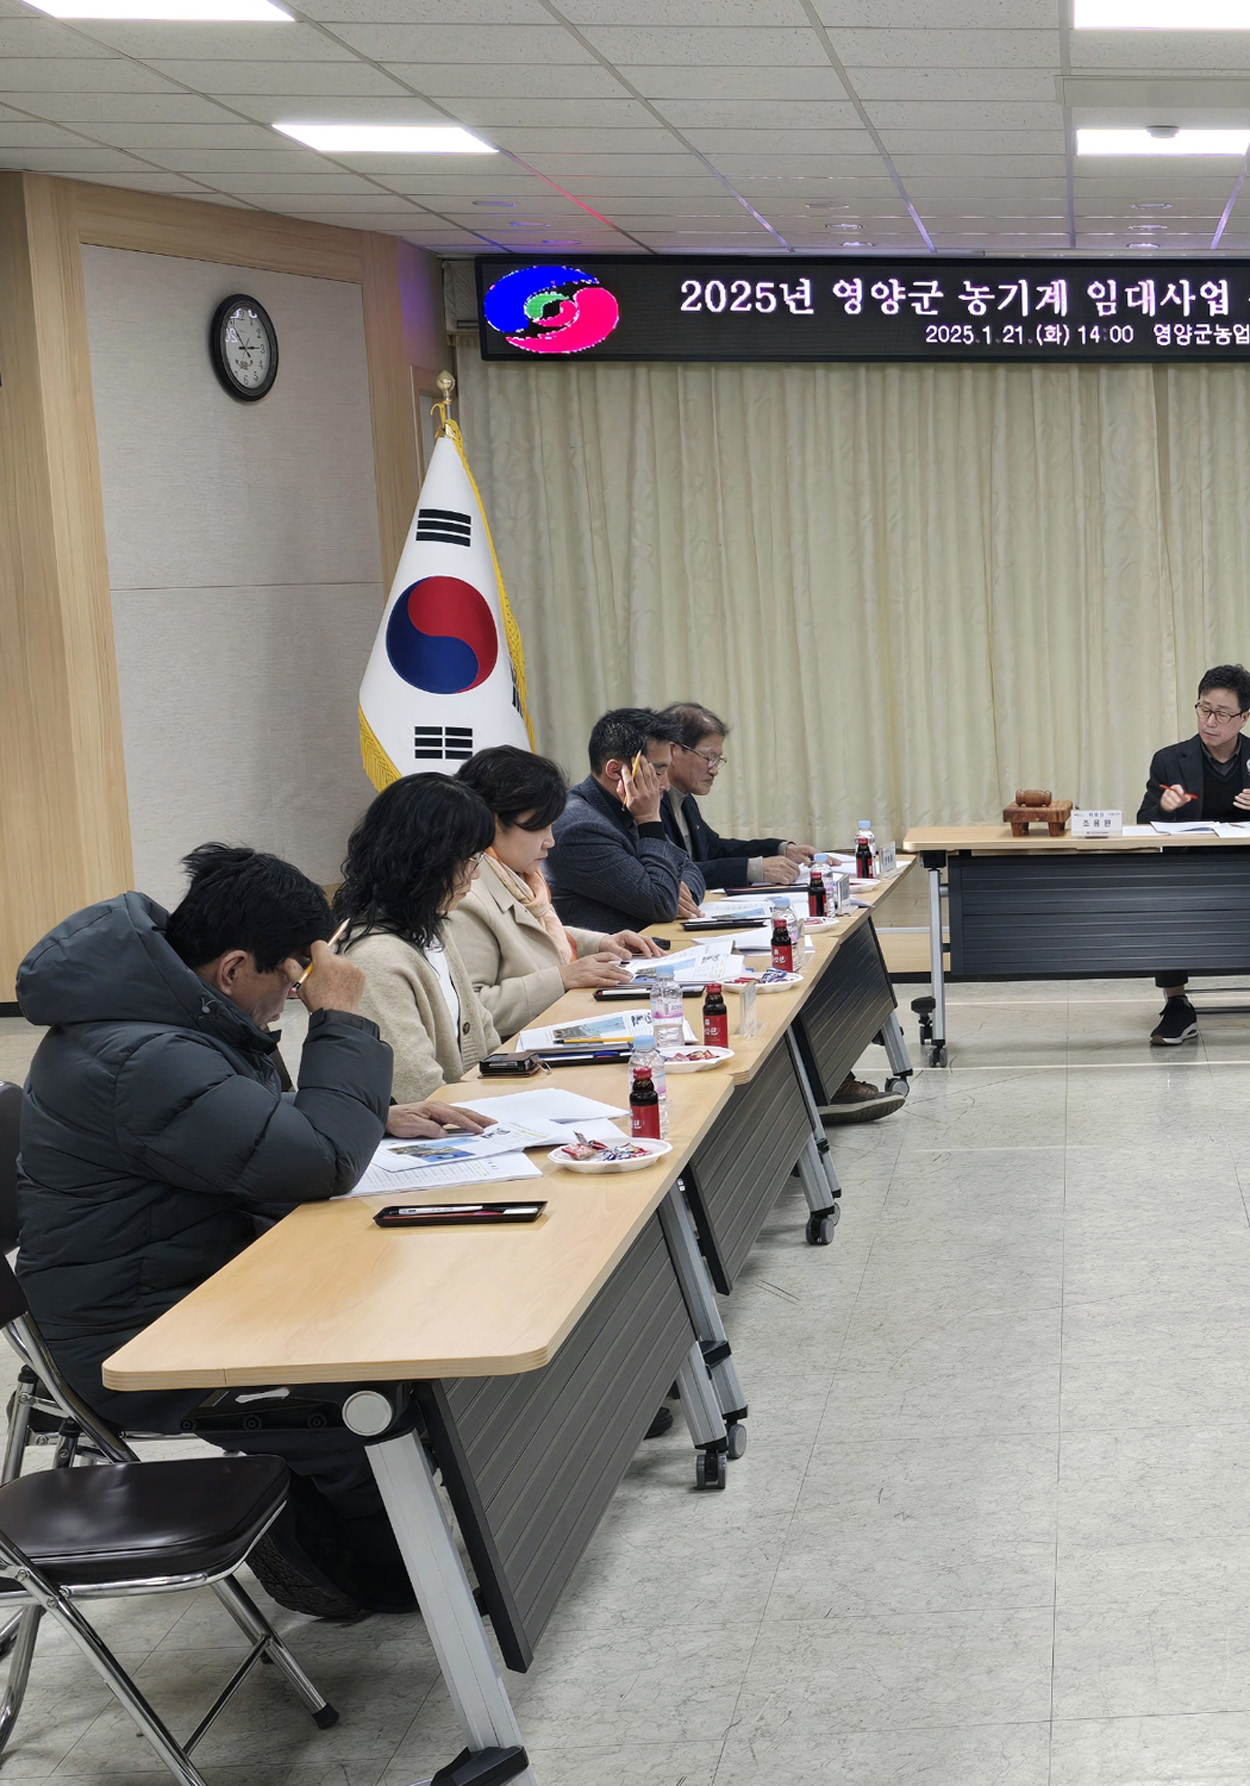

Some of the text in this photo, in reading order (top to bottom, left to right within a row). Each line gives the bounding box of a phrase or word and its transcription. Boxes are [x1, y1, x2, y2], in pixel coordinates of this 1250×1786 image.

[680, 277, 815, 315] 2025년
[832, 277, 944, 316] 영양군
[957, 278, 1068, 317] 농기계
[1086, 278, 1229, 318] 임대사업
[1077, 324, 1134, 345] 14:00
